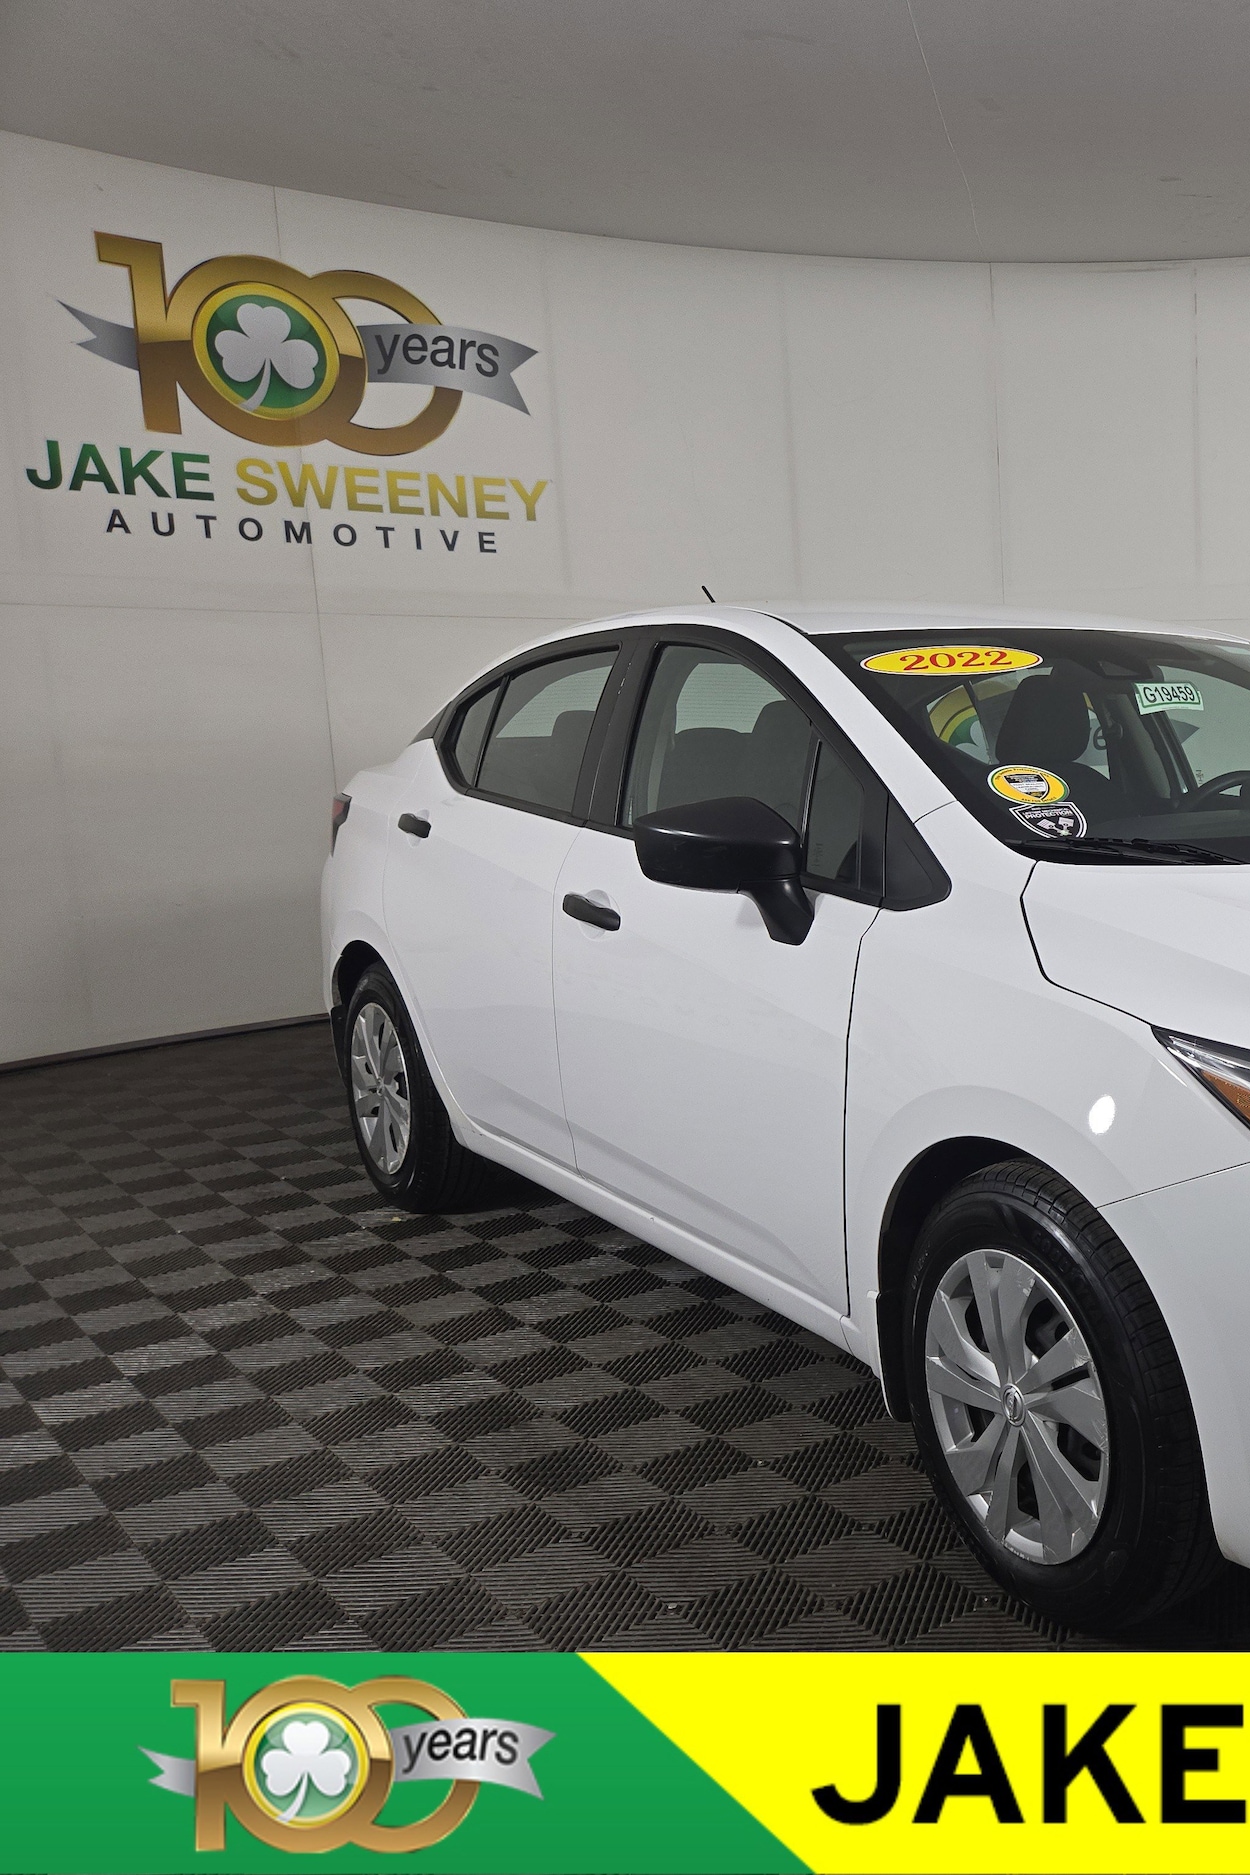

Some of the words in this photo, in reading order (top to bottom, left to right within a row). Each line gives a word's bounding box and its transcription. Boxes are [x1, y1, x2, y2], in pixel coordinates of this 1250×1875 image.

[374, 331, 500, 378] years
[26, 439, 215, 502] JAKE
[235, 457, 548, 522] SWEENEY
[105, 508, 498, 554] AUTOMOTIVE
[899, 650, 1013, 671] 2022
[1143, 686, 1195, 703] G19459
